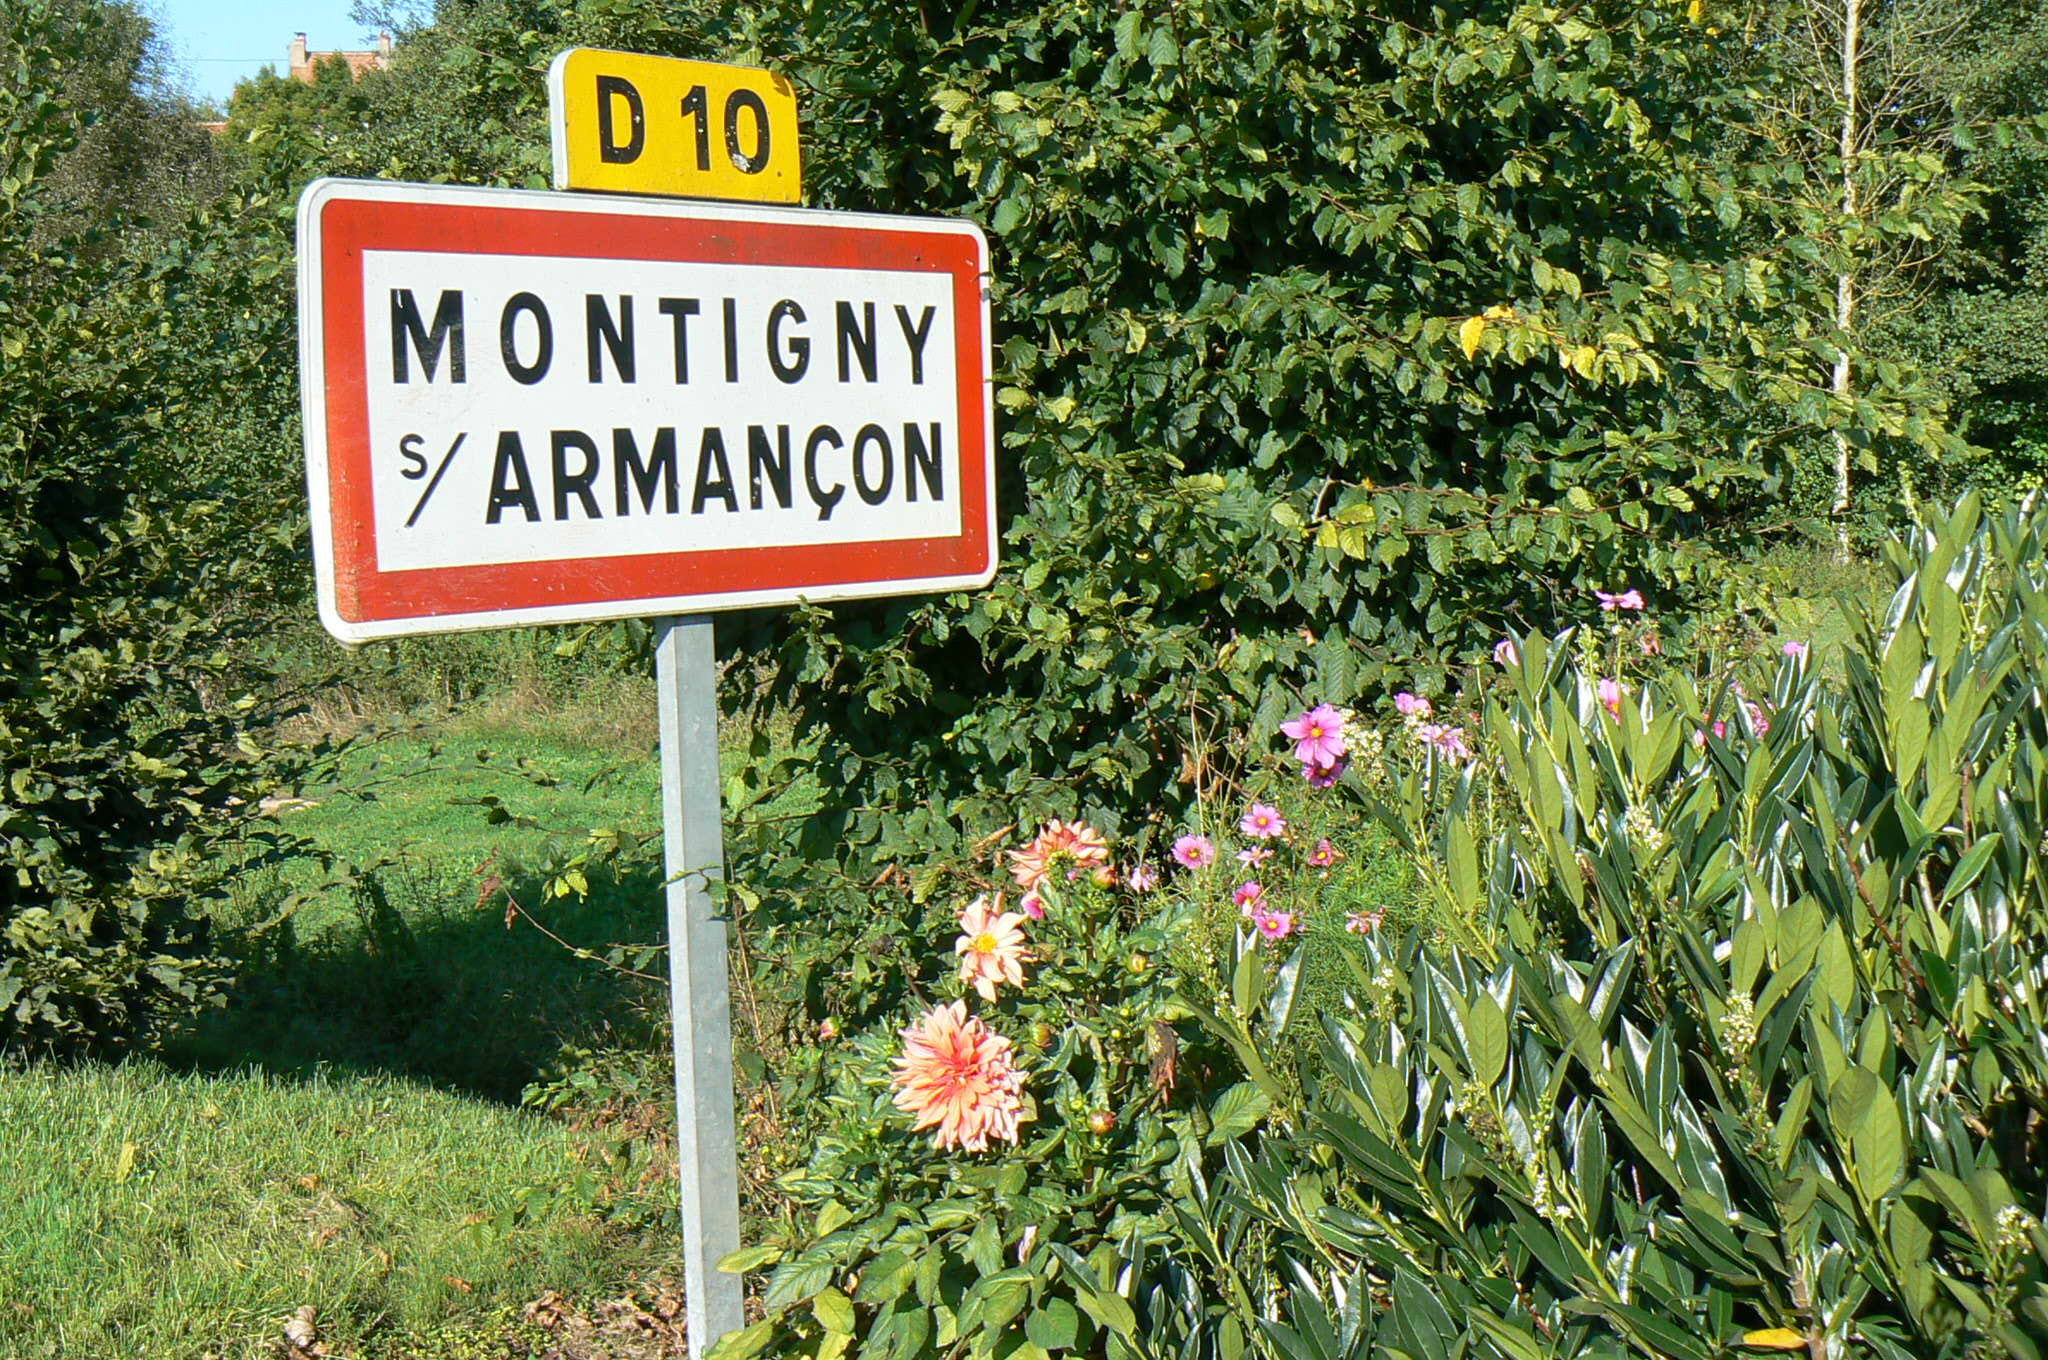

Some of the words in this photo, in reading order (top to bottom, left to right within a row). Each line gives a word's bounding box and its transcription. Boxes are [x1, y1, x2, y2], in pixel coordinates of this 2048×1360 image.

[595, 75, 646, 164] D
[680, 84, 770, 174] 10
[389, 288, 936, 385] MONTIGNY
